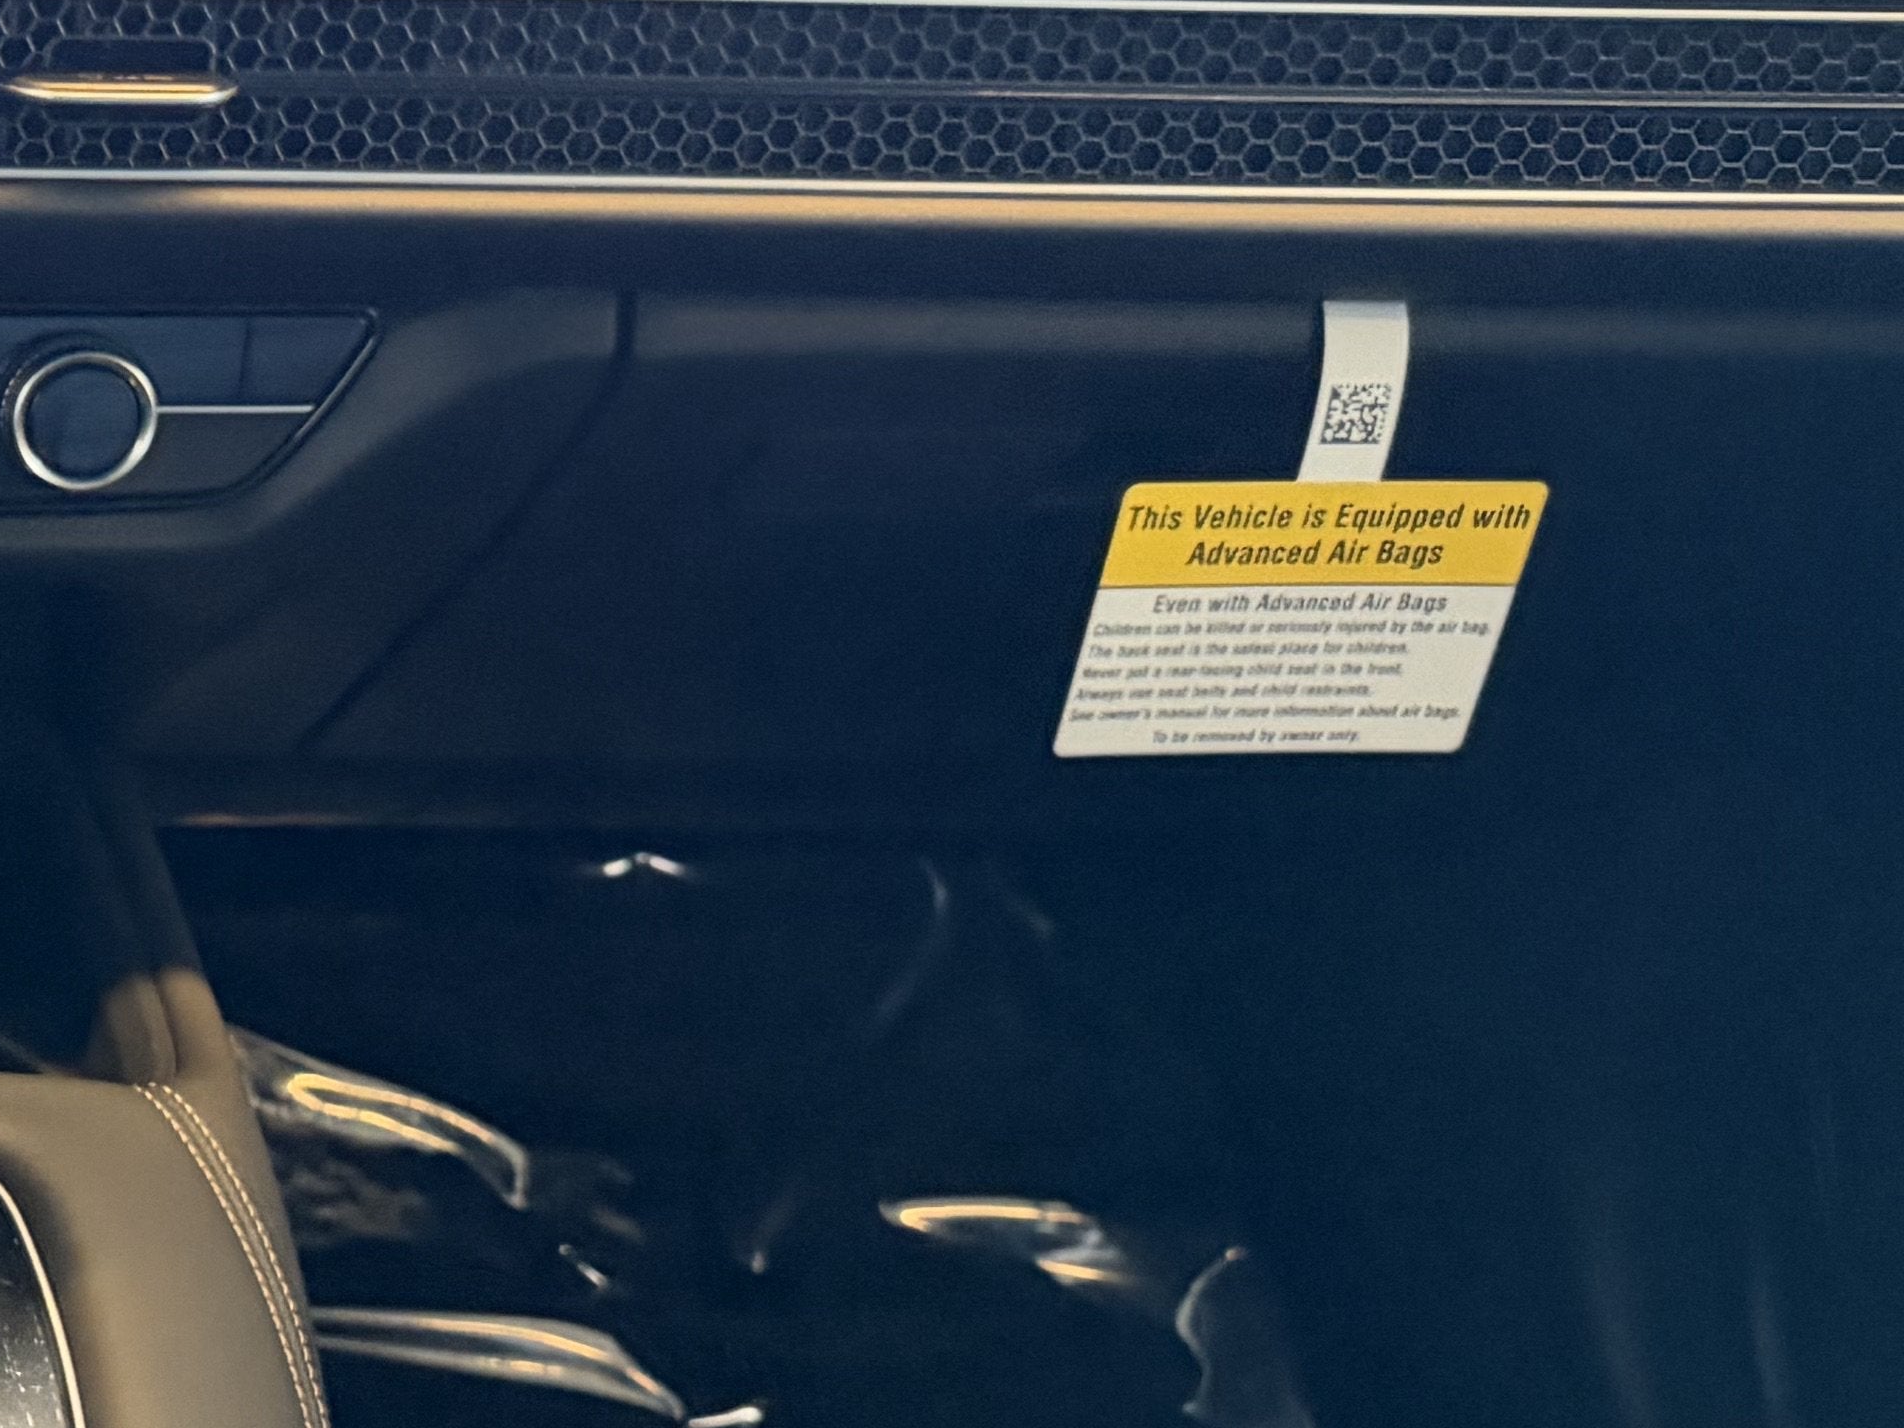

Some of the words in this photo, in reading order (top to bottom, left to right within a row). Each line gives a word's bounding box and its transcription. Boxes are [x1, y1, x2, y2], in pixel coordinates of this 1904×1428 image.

[1128, 505, 1182, 531] This
[1194, 504, 1292, 530] Vehicle
[1301, 503, 1325, 529] is
[1335, 503, 1465, 534] Equipped
[1473, 504, 1531, 529] with
[1185, 540, 1318, 566] Advanced
[1327, 540, 1369, 565] Air
[1376, 540, 1445, 570] Bags
[1153, 595, 1201, 613] Even
[1208, 595, 1250, 612] with
[1255, 593, 1356, 612] Advanced
[1360, 593, 1392, 611] Air
[1396, 593, 1448, 615] Bags
